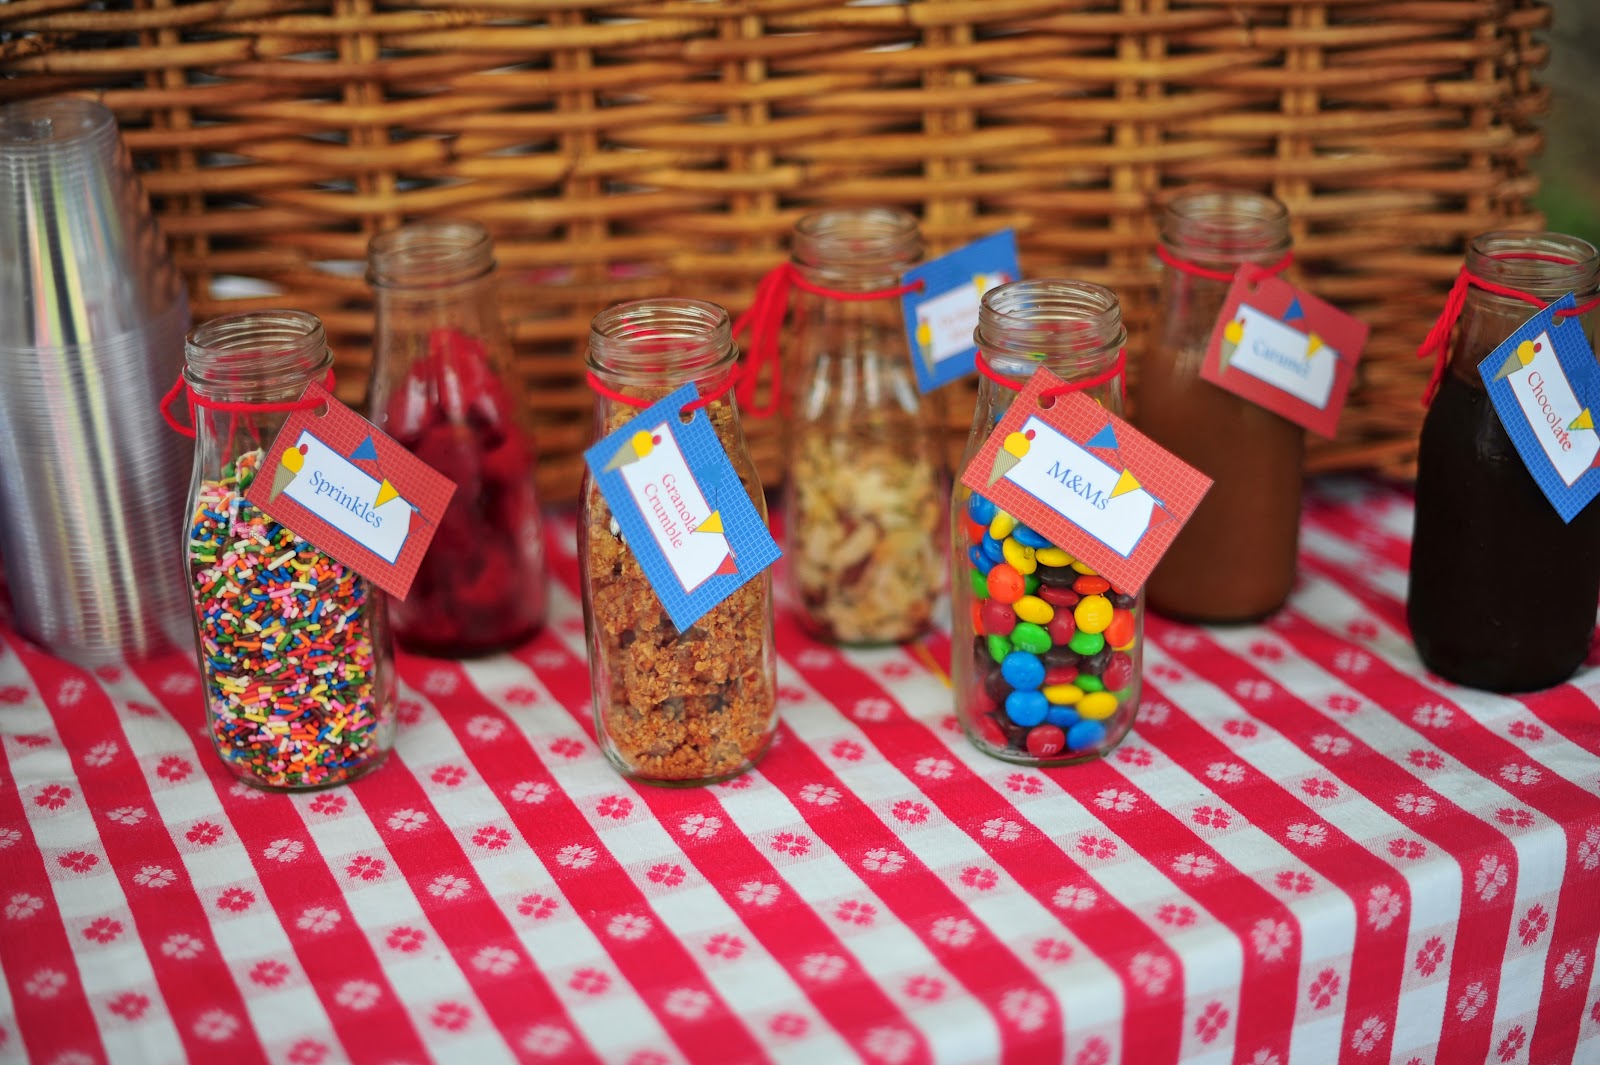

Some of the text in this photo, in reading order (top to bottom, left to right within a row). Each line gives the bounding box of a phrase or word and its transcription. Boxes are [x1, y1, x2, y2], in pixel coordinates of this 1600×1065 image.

[1527, 371, 1572, 452] Chocolate
[309, 470, 383, 528] Sprinkles
[662, 473, 698, 535] Granola
[1046, 460, 1109, 511] M&Ms
[644, 483, 683, 549] Crumble
[1041, 743, 1057, 753] m
